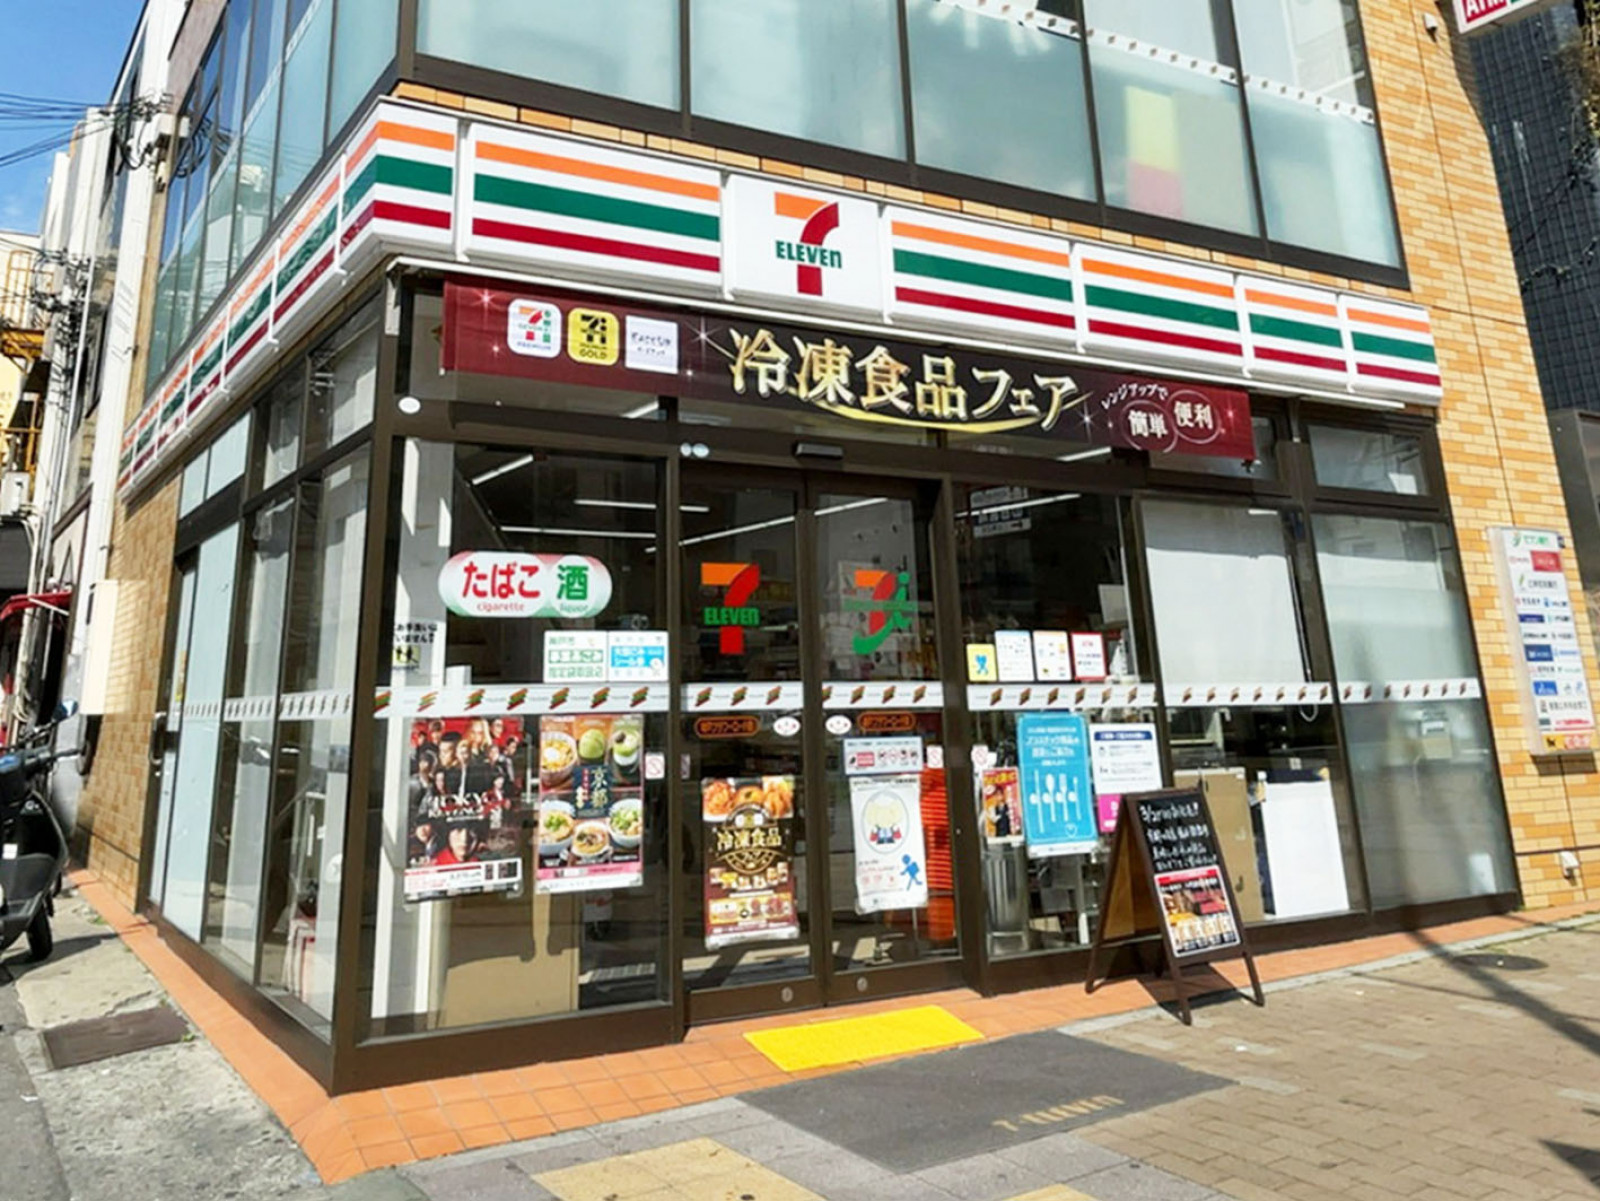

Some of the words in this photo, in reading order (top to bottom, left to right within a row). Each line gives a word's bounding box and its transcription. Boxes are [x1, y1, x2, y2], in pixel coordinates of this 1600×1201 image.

[774, 191, 840, 297] 7
[579, 348, 608, 360] GOLD
[729, 328, 1079, 431] 冷凍食品フェア
[1101, 383, 1169, 410] レンジアップで
[1128, 409, 1168, 438] 簡単
[1174, 401, 1213, 430] 便利
[463, 561, 540, 599] たばこ
[557, 564, 589, 600] 酒
[477, 602, 525, 612] cigarette
[716, 827, 782, 852] 冷凍食品
